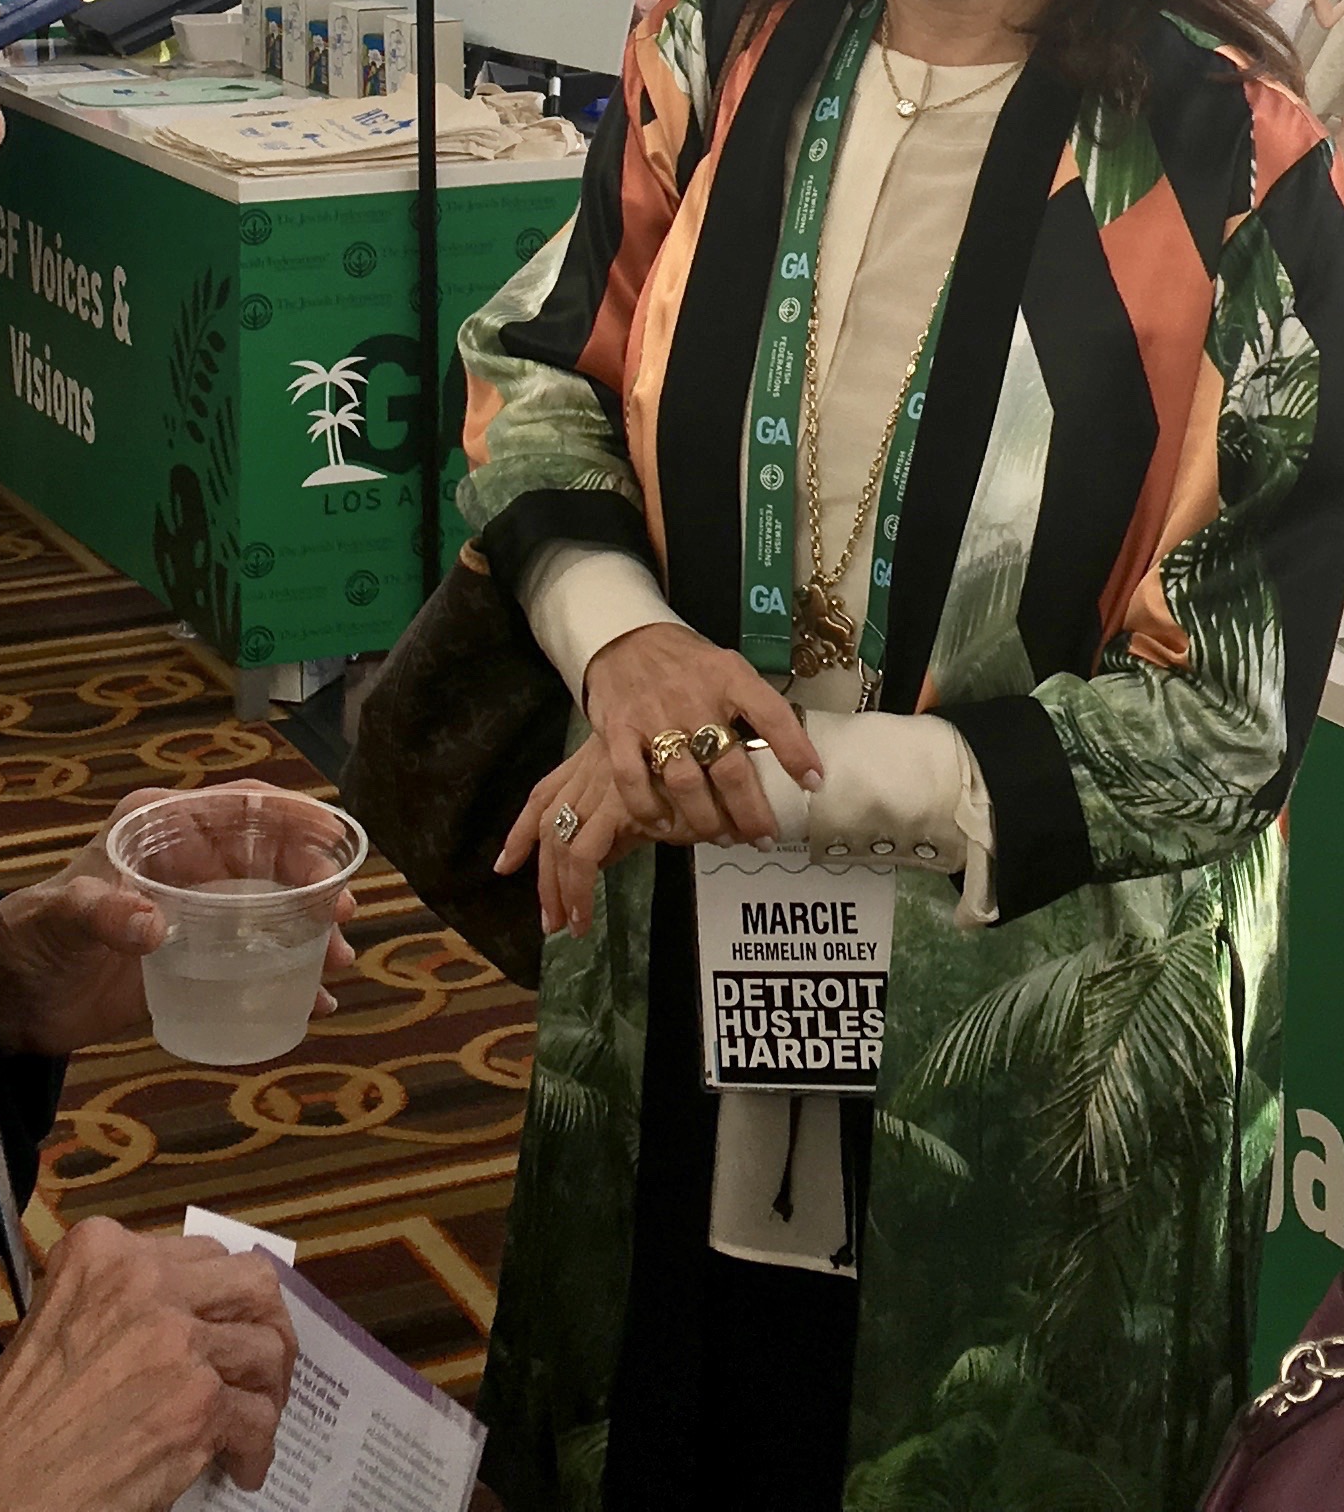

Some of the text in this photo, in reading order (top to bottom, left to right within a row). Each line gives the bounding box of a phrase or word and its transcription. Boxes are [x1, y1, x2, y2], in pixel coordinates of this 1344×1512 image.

[815, 96, 840, 122] GA
[781, 252, 810, 280] GA
[28, 219, 104, 329] Voices
[113, 265, 133, 346] &
[773, 336, 788, 398] FEDERATIONS
[784, 350, 794, 384] JEWISH
[9, 324, 96, 444] Visions
[907, 391, 926, 419] G
[756, 416, 792, 446] GA
[892, 451, 906, 485] JEWISH
[324, 489, 381, 515] LOS
[764, 504, 773, 568] FEDERATIONS
[774, 519, 782, 554] JEWISH
[749, 584, 787, 616] GA
[776, 845, 808, 853] ANGELE
[741, 902, 858, 935] MARCIE
[732, 942, 877, 961] HERMELIN ORLEY
[716, 978, 884, 1008] DETROIT
[718, 1009, 884, 1038] HUSTLES
[720, 1038, 883, 1070] HARDER
